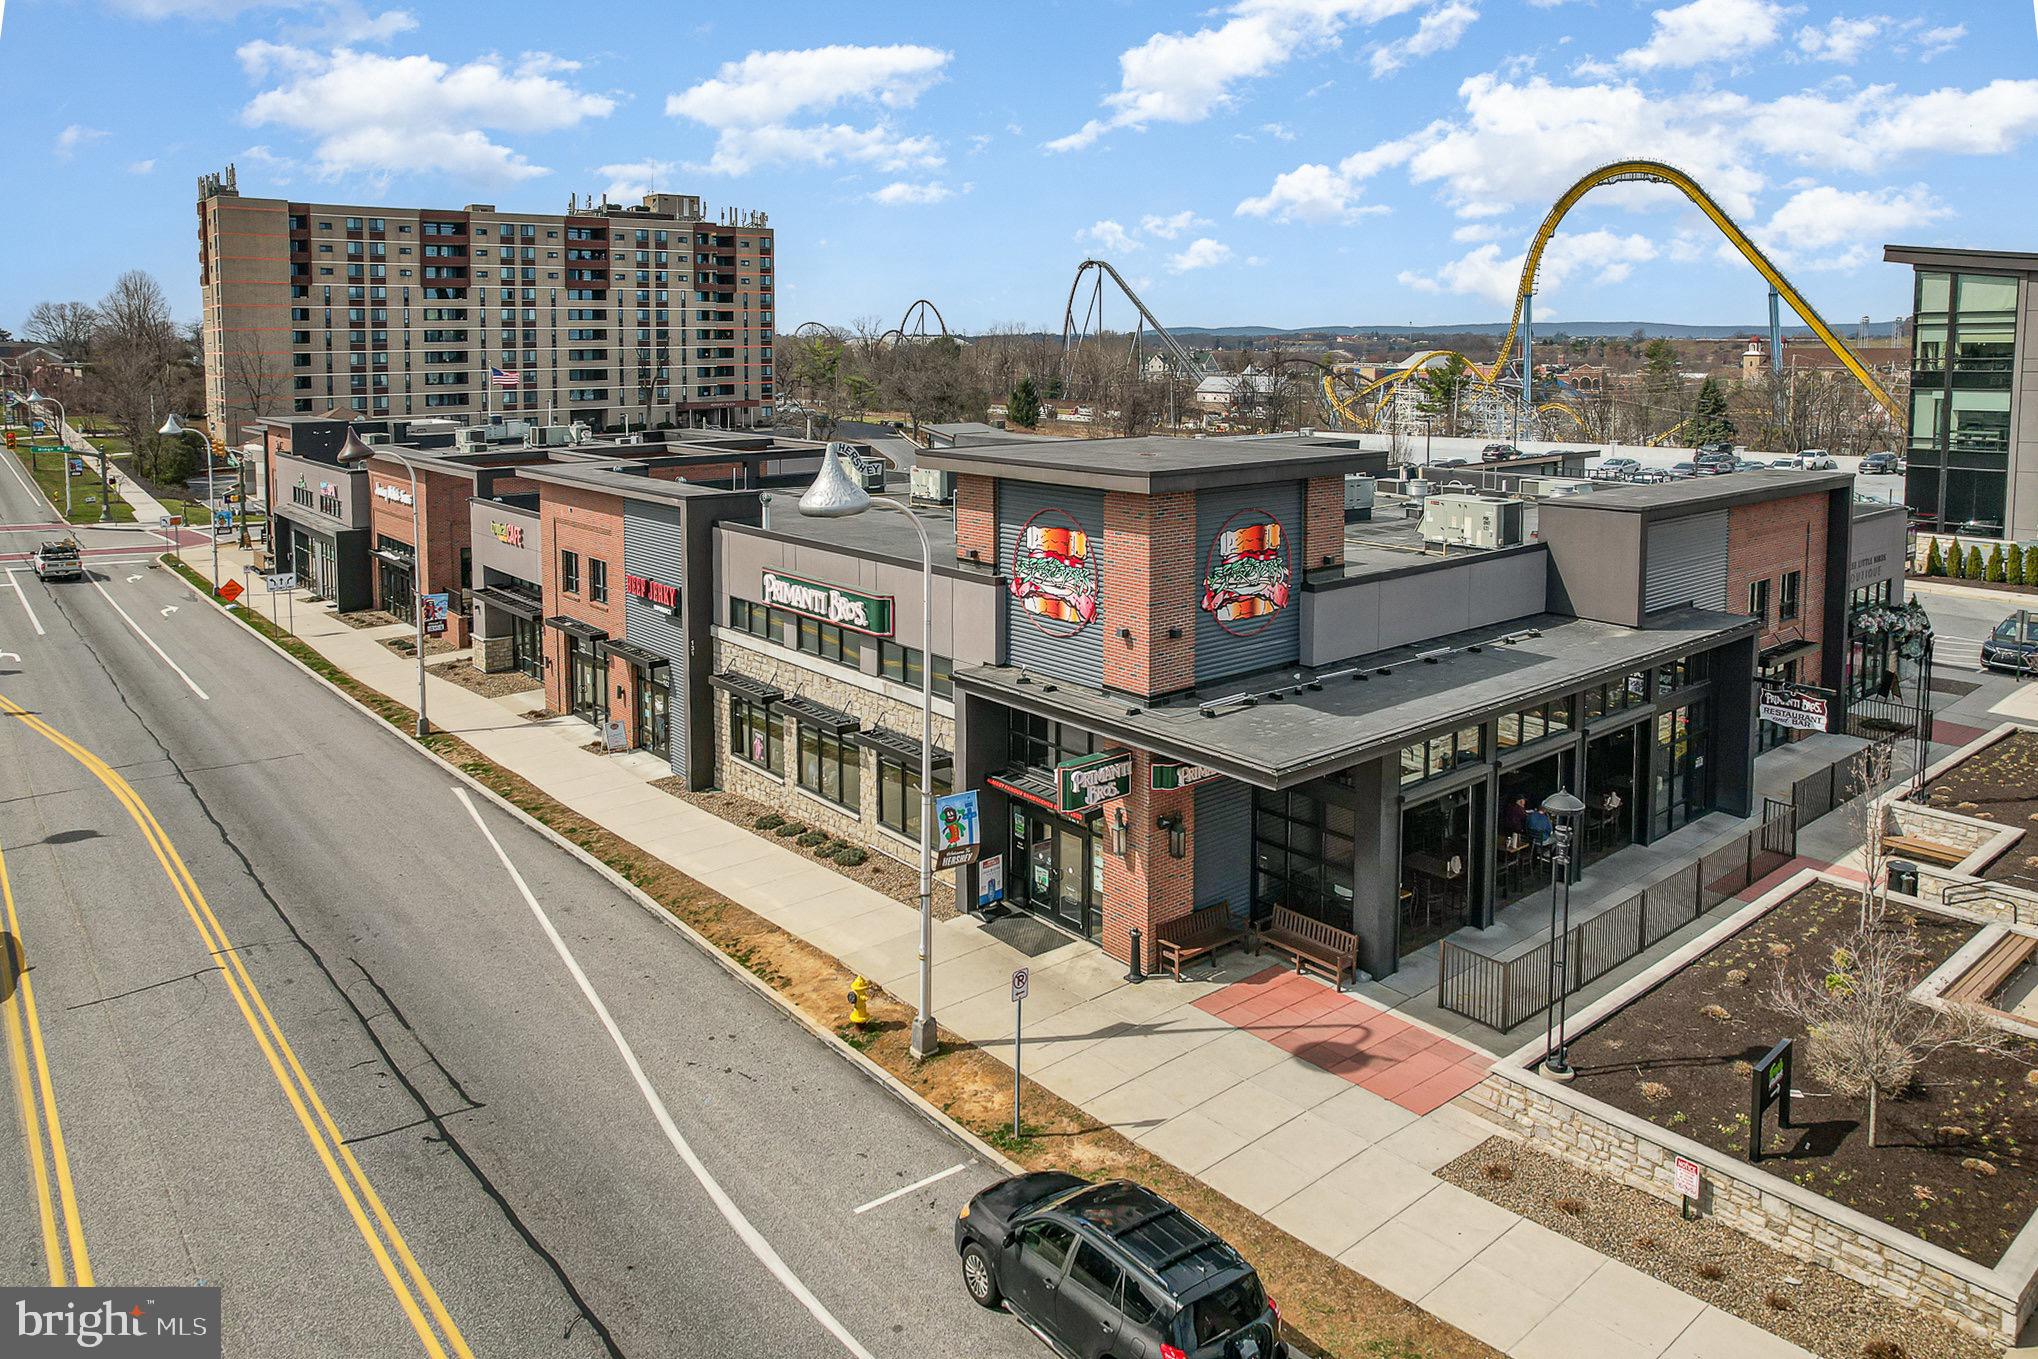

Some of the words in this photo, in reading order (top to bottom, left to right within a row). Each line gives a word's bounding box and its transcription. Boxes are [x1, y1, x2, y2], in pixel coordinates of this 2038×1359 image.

[838, 443, 880, 475] HERSHEY
[648, 580, 677, 609] JERKY
[763, 573, 828, 615] PRIMANTI
[1763, 707, 1822, 724] RESTAURANT
[1792, 718, 1811, 728] BAR
[1070, 760, 1133, 793] PRIMANTI
[941, 852, 974, 867] HERSHEY
